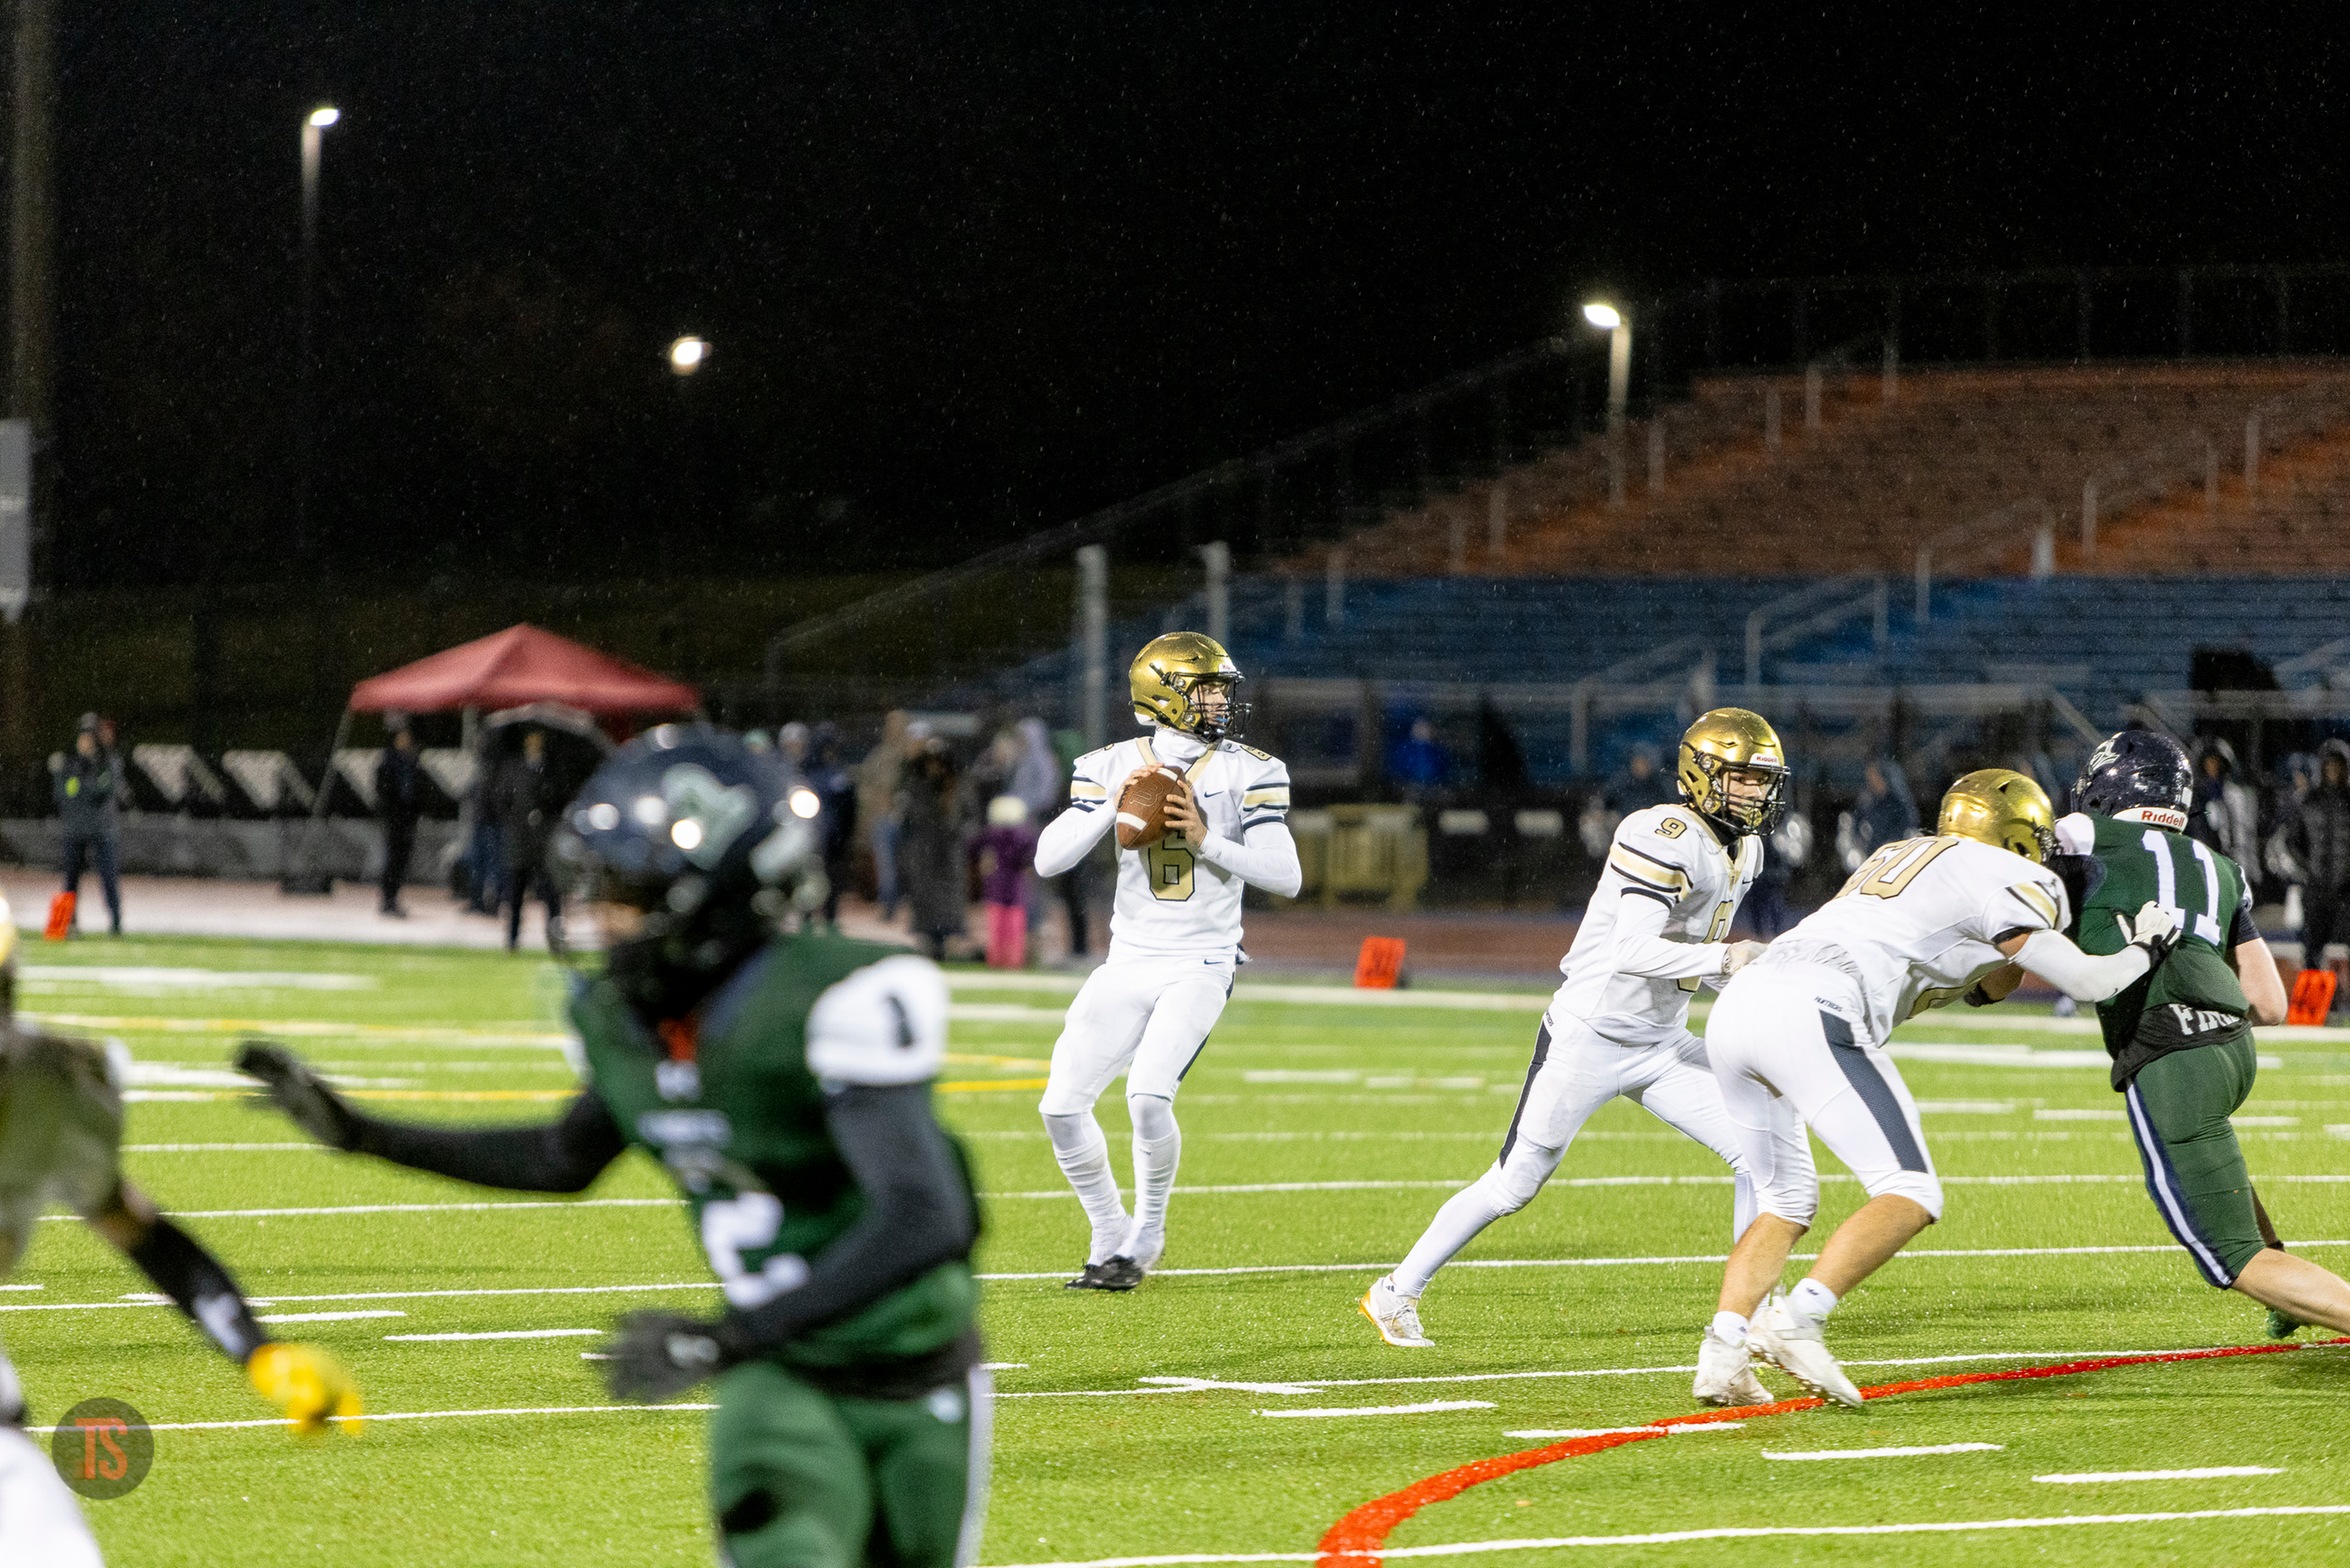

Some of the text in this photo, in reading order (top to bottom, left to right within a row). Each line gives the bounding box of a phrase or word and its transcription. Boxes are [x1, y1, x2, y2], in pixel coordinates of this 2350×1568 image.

[1655, 817, 1687, 839] 9
[2141, 810, 2185, 828] Riddell
[1147, 827, 1195, 902] 6
[2142, 829, 2221, 946] 11
